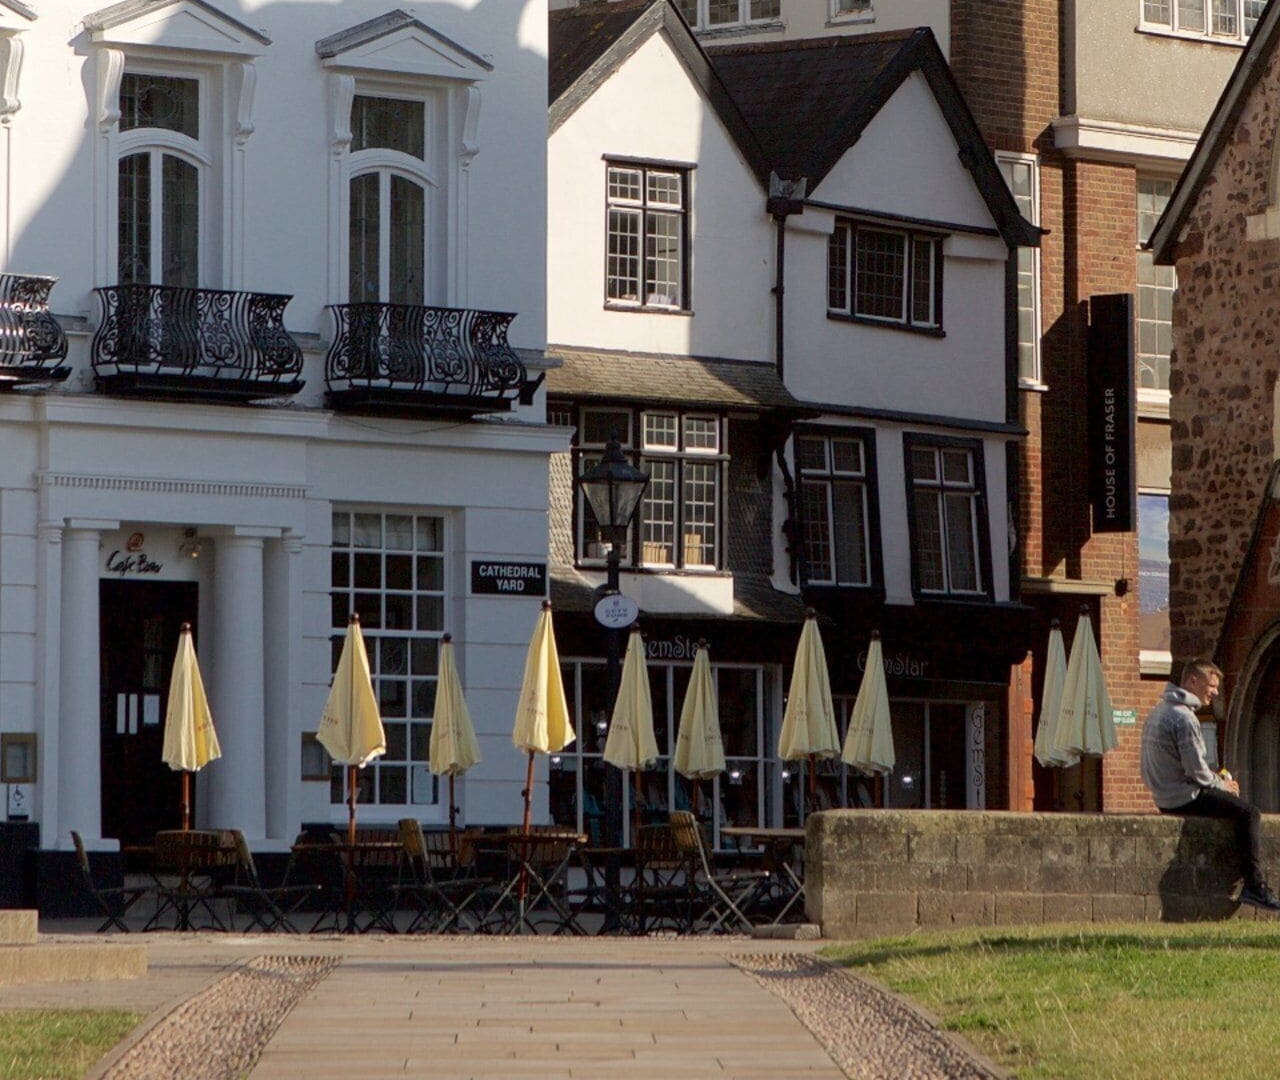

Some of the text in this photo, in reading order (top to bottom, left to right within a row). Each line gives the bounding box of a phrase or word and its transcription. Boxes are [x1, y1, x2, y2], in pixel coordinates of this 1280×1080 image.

[1105, 388, 1116, 519] HOUSE OF FRASER
[479, 565, 541, 578] CATHEDRAL
[496, 579, 525, 592] YARD
